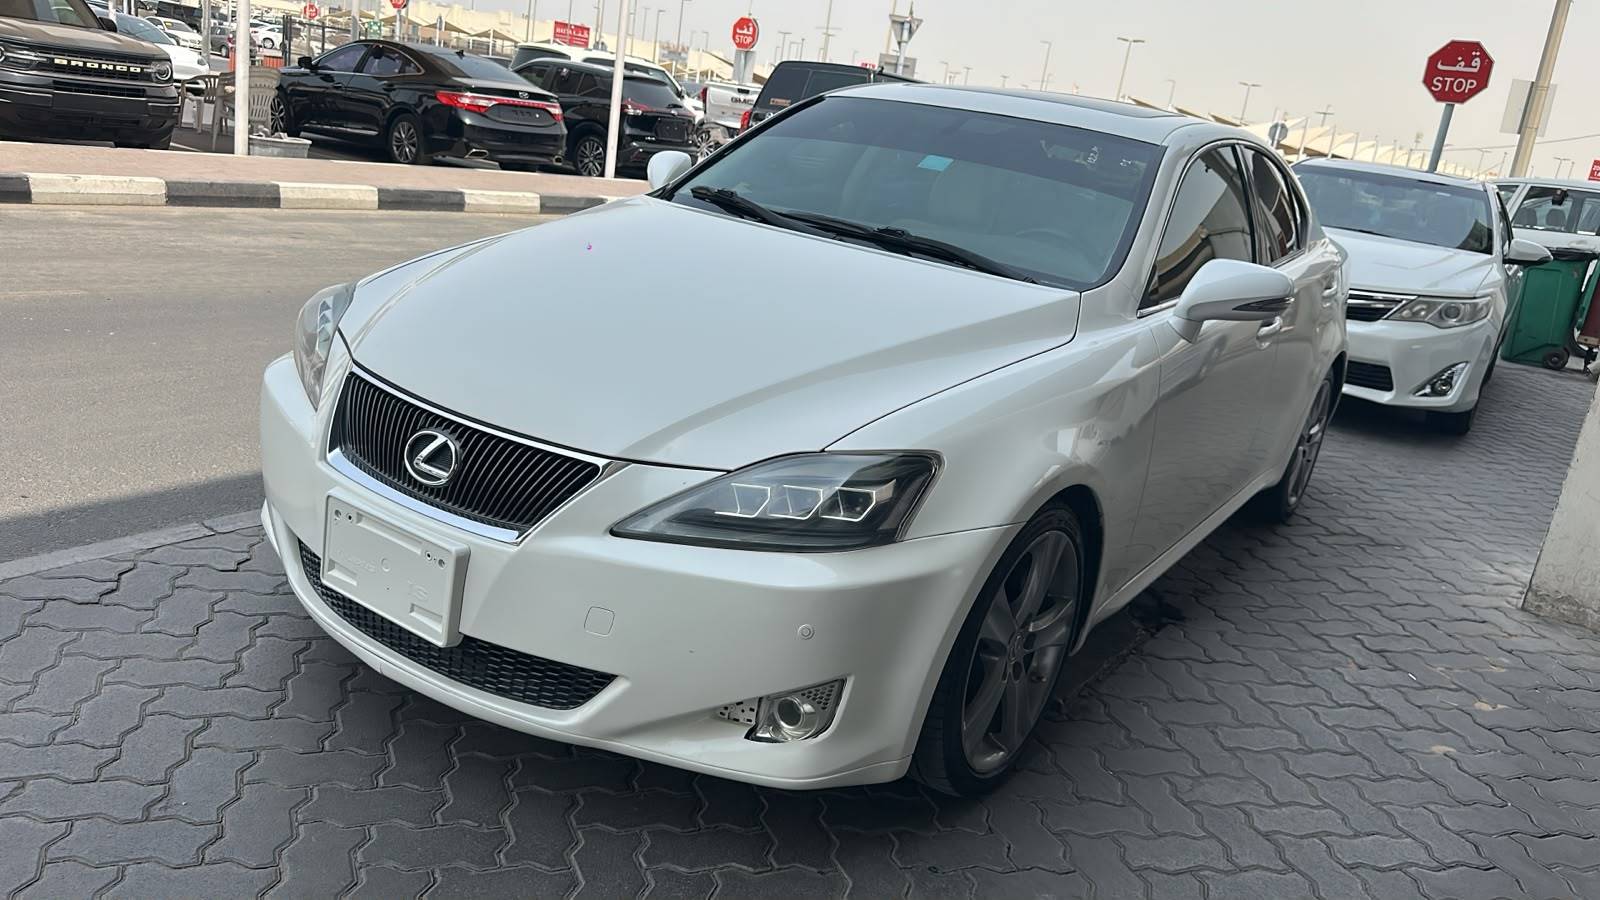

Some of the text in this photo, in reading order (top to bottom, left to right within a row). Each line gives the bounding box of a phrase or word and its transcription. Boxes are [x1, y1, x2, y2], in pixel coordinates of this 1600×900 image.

[735, 34, 753, 45] STOP
[54, 58, 141, 73] BRONCO
[1437, 51, 1481, 73] قف
[1431, 76, 1477, 94] STOP
[731, 96, 754, 106] GMC
